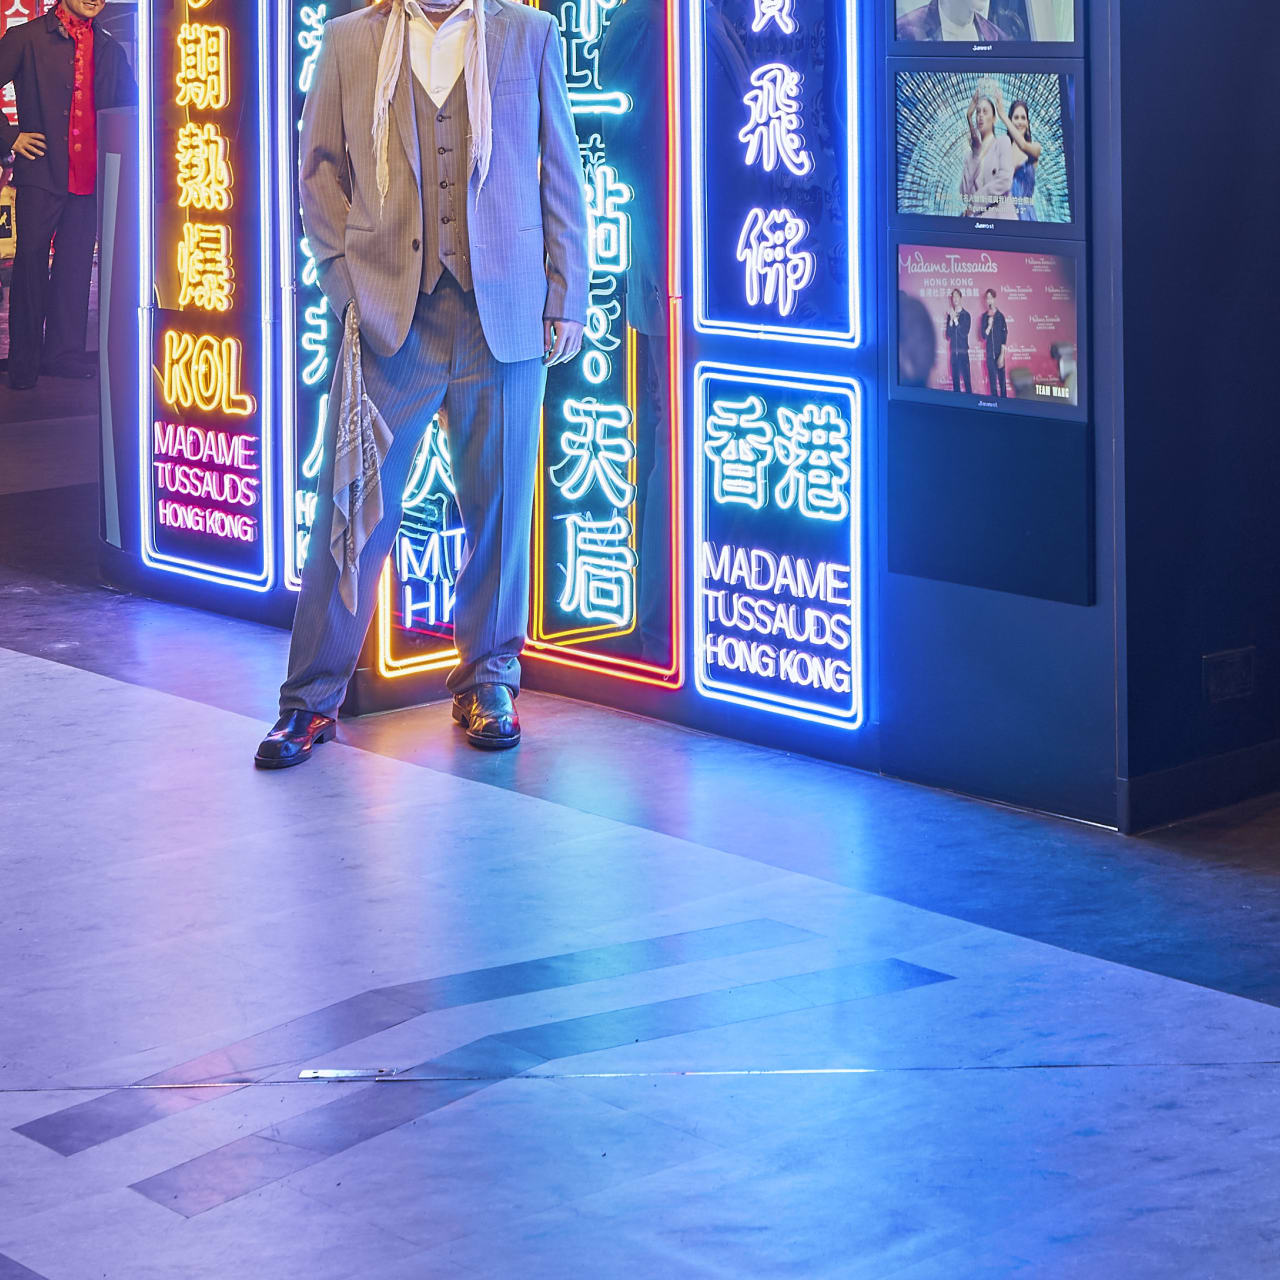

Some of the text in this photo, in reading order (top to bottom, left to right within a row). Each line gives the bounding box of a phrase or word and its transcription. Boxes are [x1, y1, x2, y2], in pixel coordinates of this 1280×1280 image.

[899, 251, 951, 274] Madame
[945, 252, 999, 274] Tussauds
[923, 277, 974, 287] HONG KONG
[163, 330, 254, 415] KOL
[154, 421, 259, 470] MADAME
[705, 396, 852, 522] 香港
[153, 462, 259, 507] TUSSAUDS
[158, 499, 204, 532] HONG
[204, 507, 258, 543] KONG
[703, 541, 853, 607] MADAME
[702, 587, 852, 651] TUSSAUDS
[706, 633, 852, 694] HONG KONG
